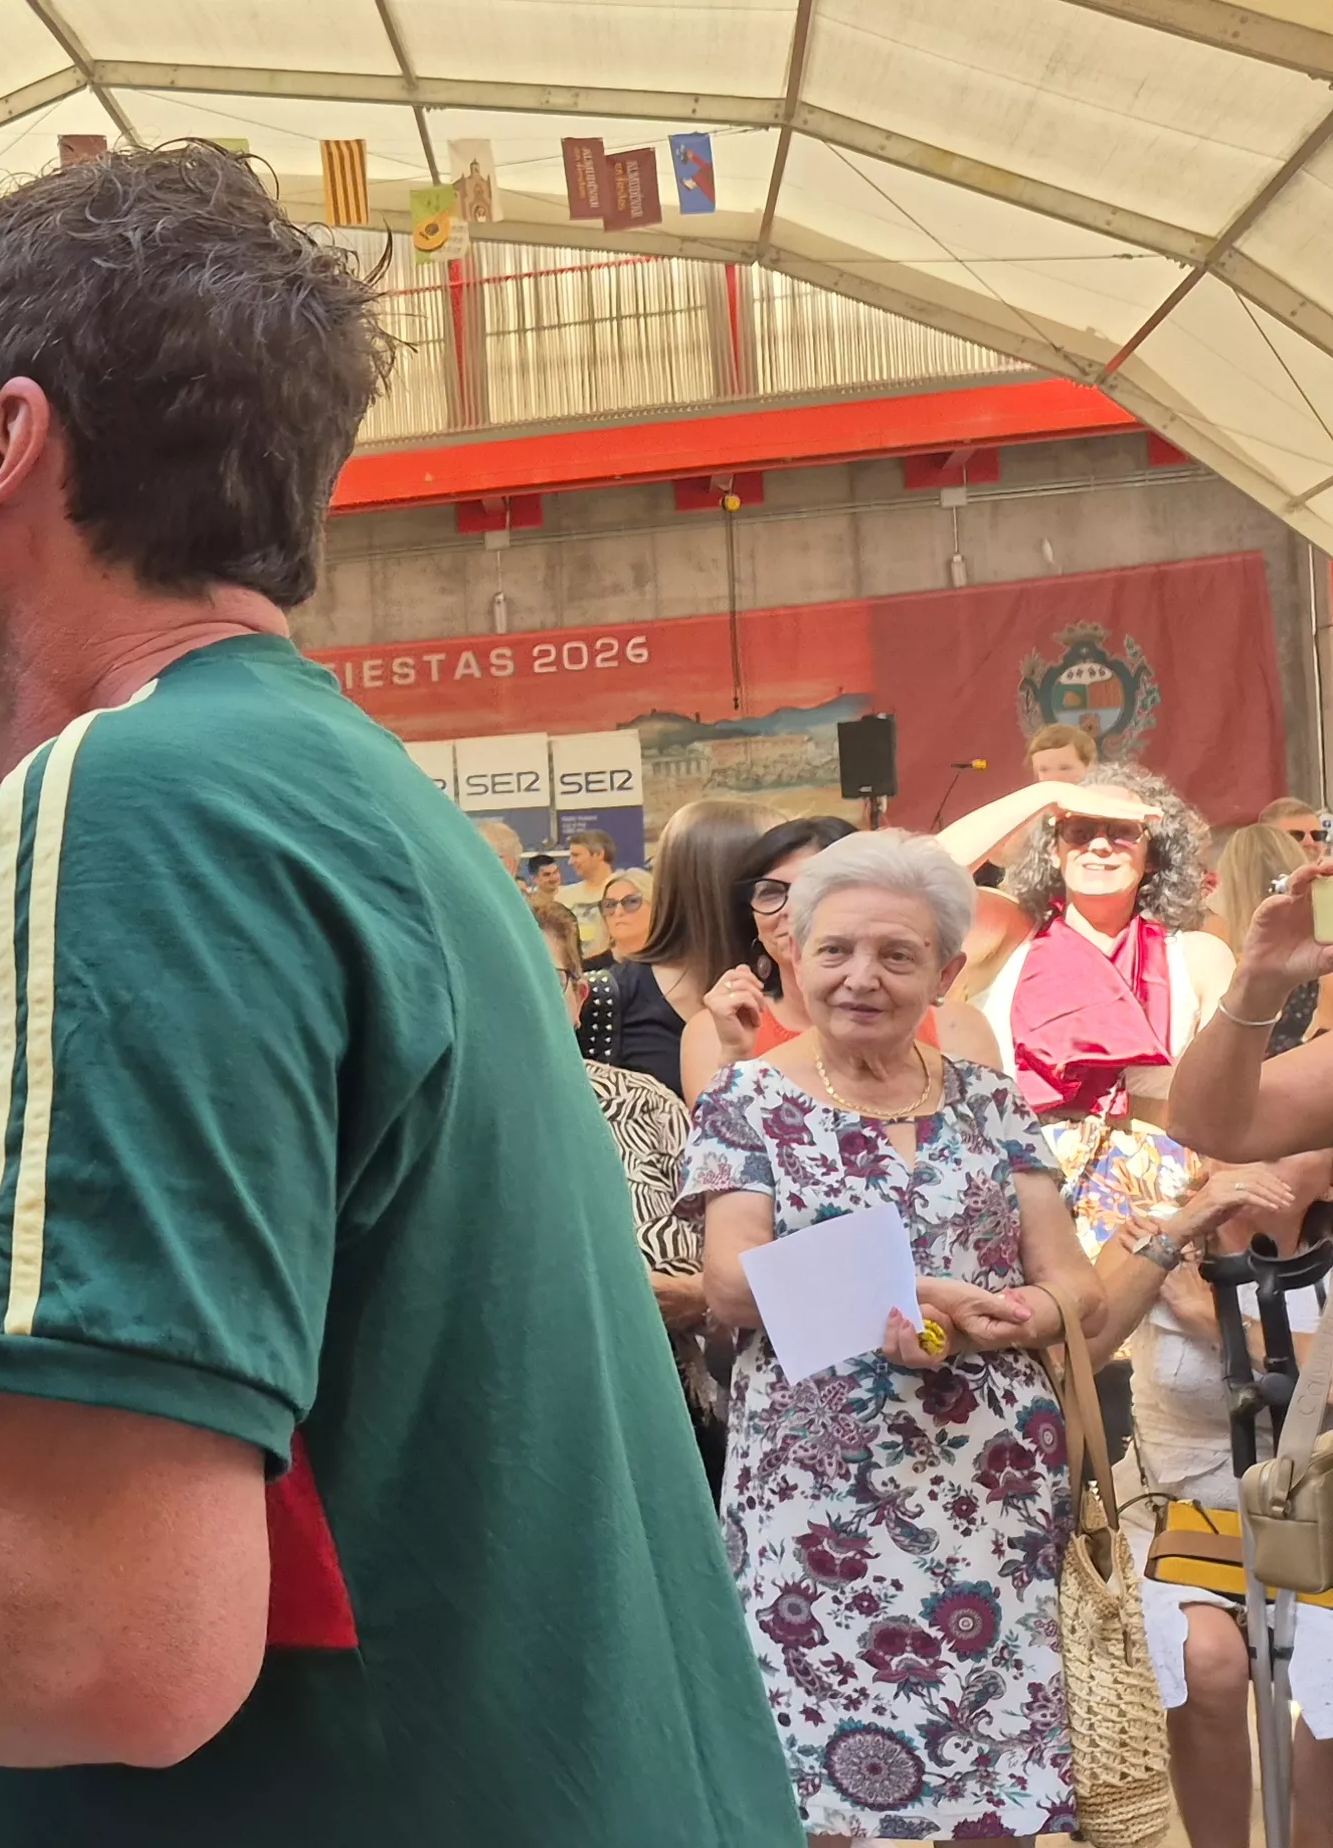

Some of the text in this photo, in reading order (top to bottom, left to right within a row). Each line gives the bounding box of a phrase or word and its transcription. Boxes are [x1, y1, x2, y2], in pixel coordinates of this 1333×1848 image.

[321, 635, 649, 690] IESTAS 2026
[466, 770, 541, 797] SER
[559, 768, 634, 796] SER
